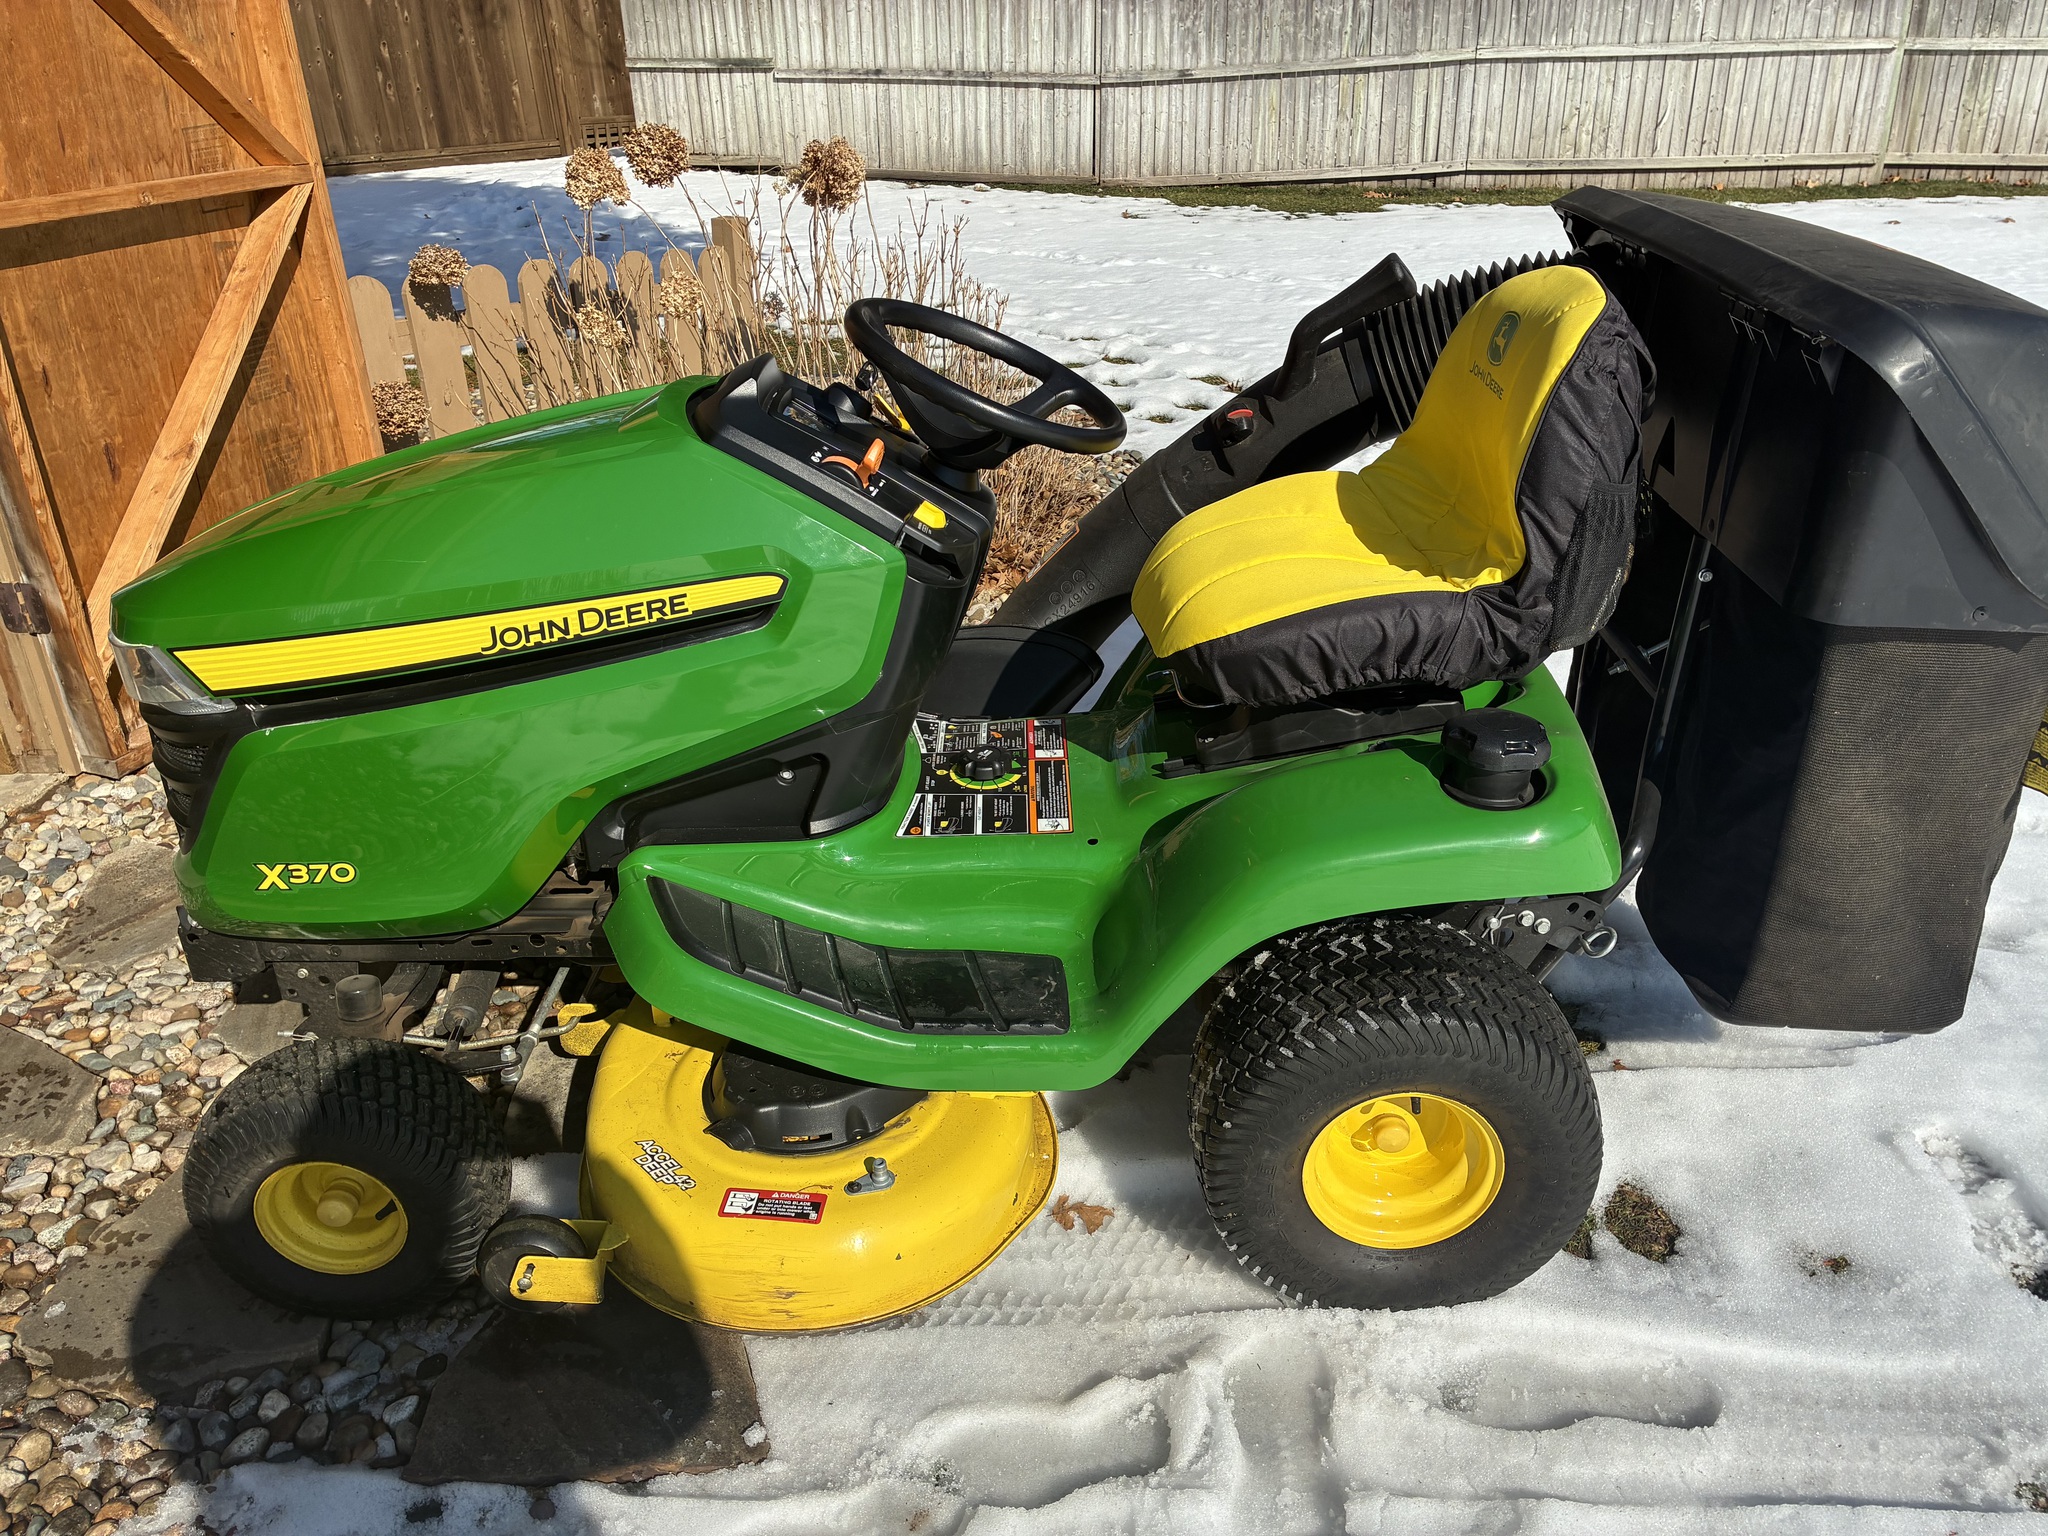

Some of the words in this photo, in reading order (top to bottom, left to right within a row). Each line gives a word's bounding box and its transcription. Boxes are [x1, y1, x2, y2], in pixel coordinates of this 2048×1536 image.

[1470, 360, 1486, 382] JOHN
[1485, 370, 1504, 400] DEERE
[480, 616, 570, 652] JOHN
[578, 594, 690, 634] DEERE
[254, 862, 356, 890] X370
[633, 1154, 678, 1184] DEEP
[634, 1140, 682, 1176] ACCEL
